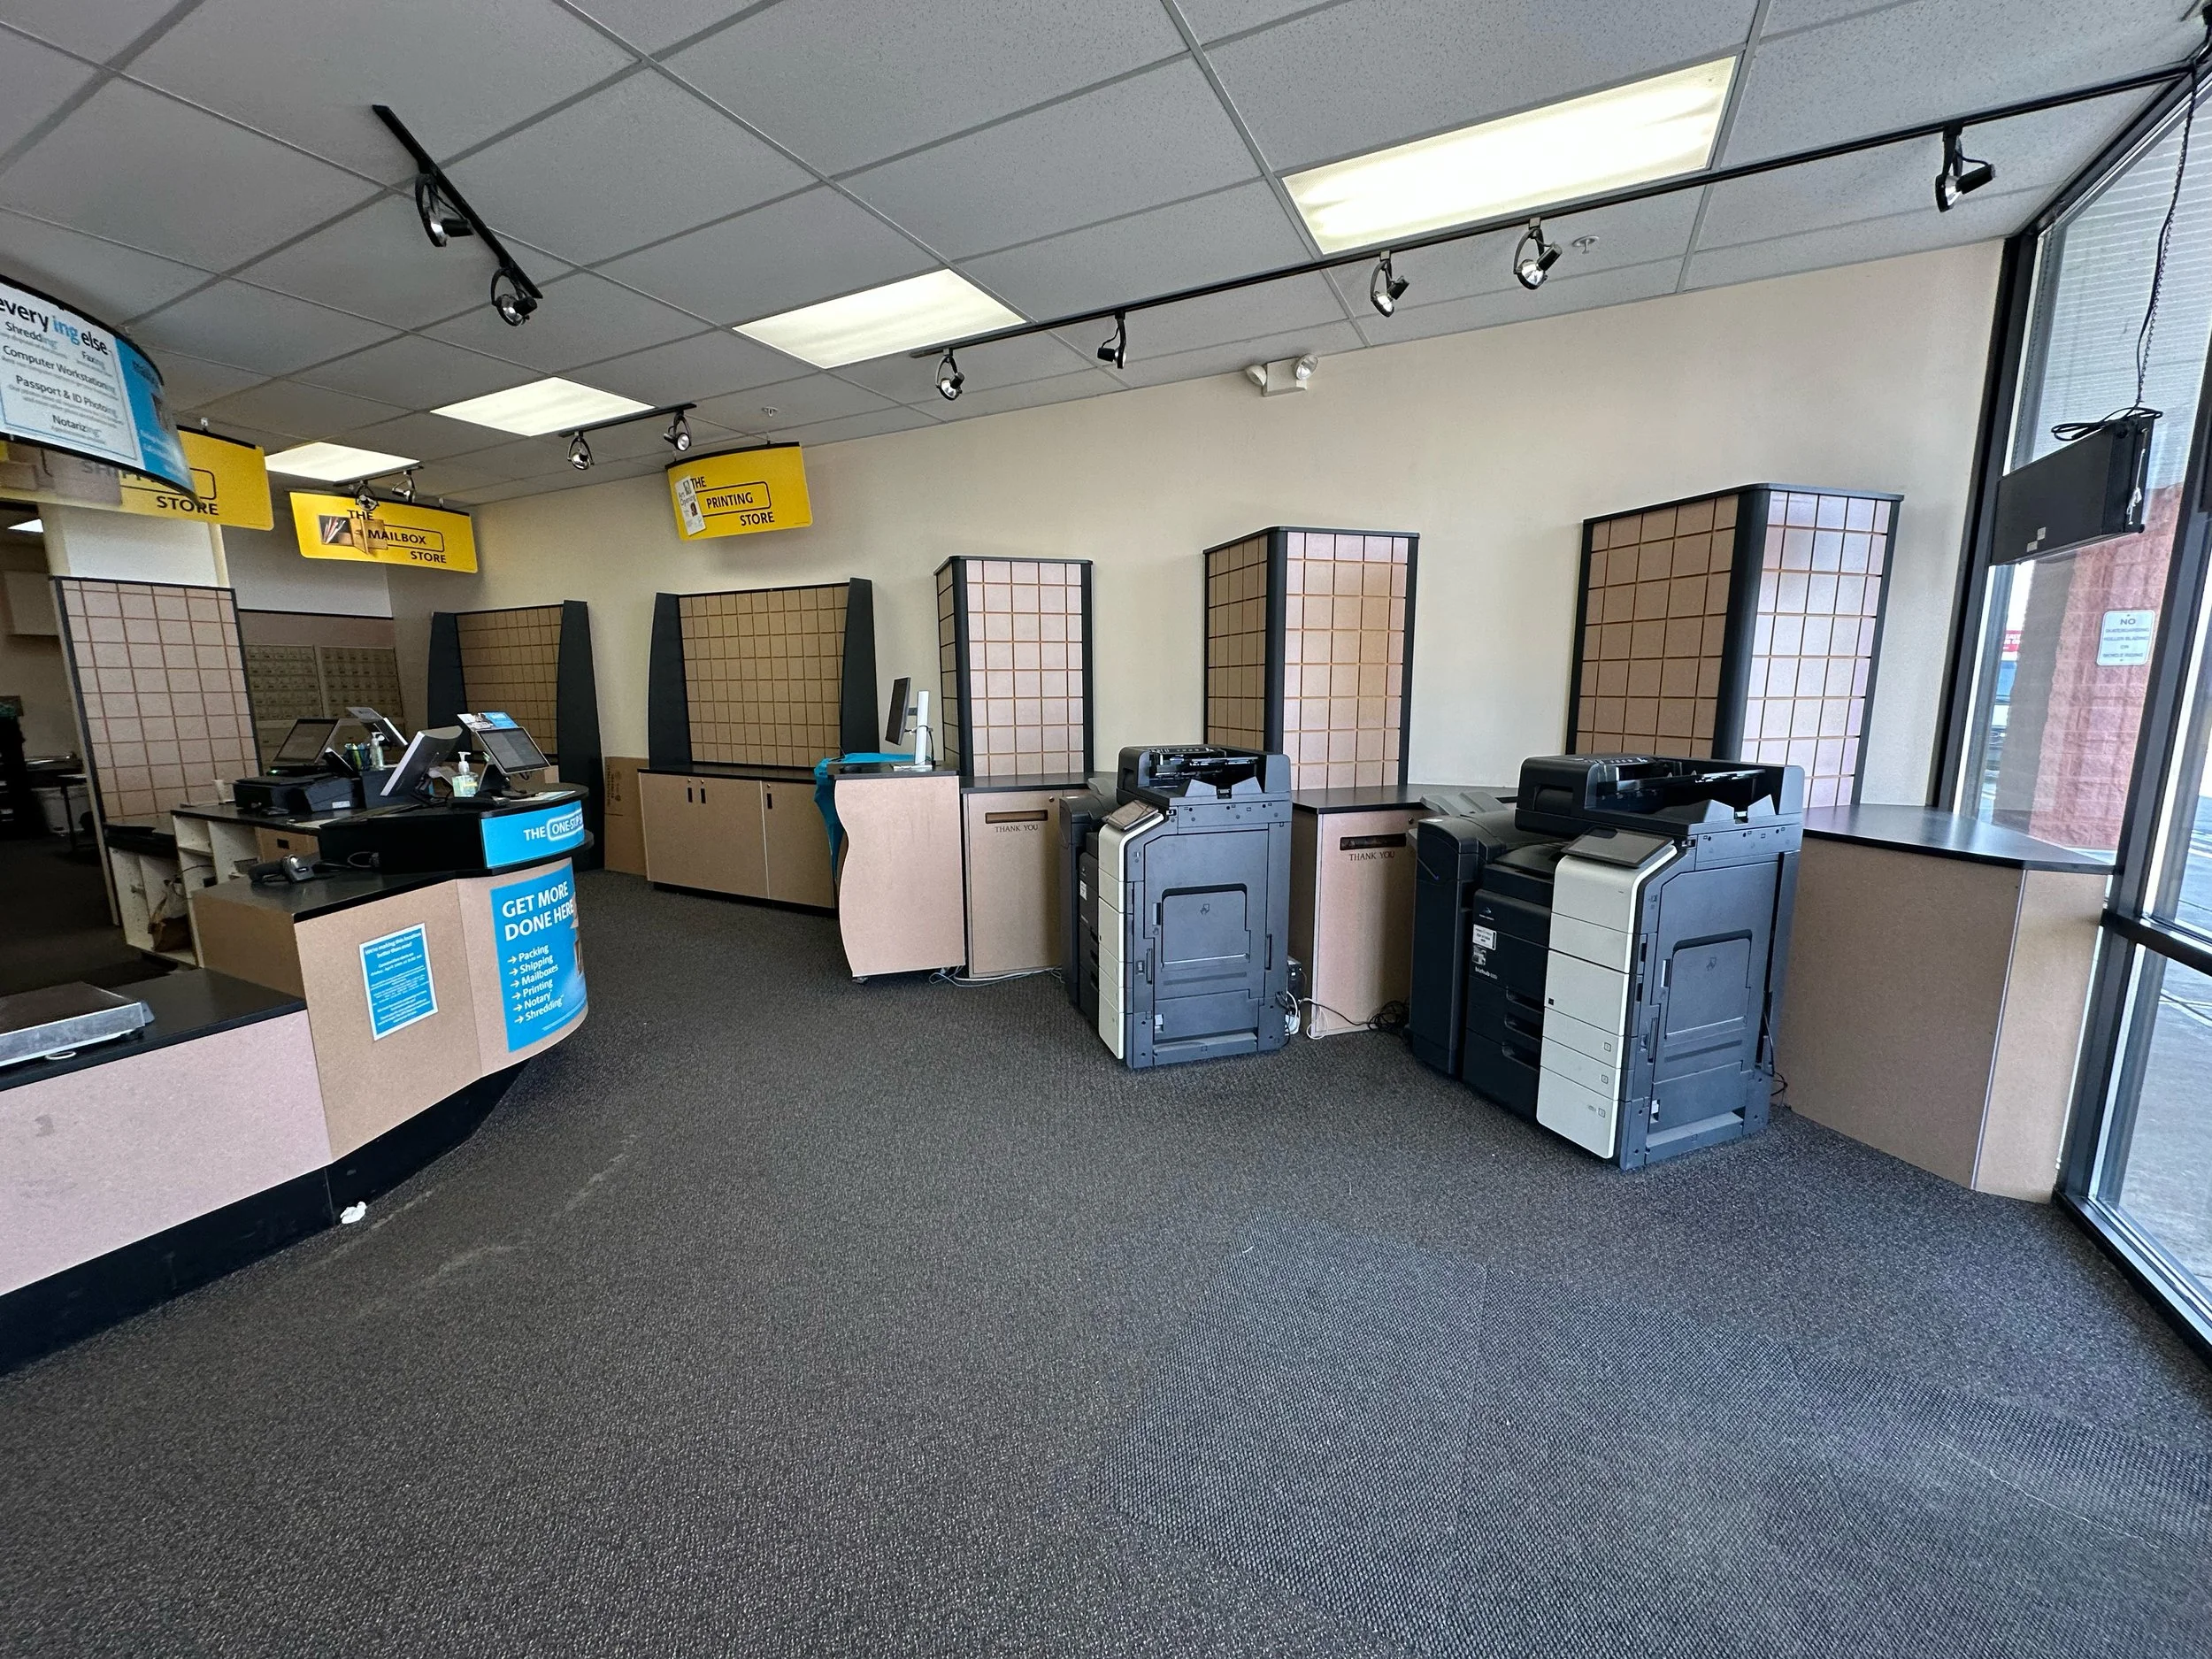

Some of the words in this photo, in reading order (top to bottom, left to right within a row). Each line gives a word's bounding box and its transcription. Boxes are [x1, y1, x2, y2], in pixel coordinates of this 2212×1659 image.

[53, 315, 81, 346] ing
[3, 345, 55, 369] Computer
[16, 374, 61, 397] Passport
[63, 389, 71, 400] &
[73, 393, 82, 403] ID
[690, 476, 707, 489] THE
[156, 495, 219, 516] STORE
[705, 492, 754, 510] PRINTING
[346, 510, 374, 521] THE
[740, 511, 775, 526] STORE
[367, 529, 427, 545] MAILBOX
[410, 550, 447, 564] STORE
[523, 826, 546, 841] THE
[1349, 852, 1377, 861] THANK
[1379, 850, 1395, 859] YOU
[502, 894, 535, 918] GET
[537, 880, 569, 909] MORE
[504, 910, 553, 941] DONE
[553, 898, 574, 924] HERE
[518, 944, 549, 962] Packing
[519, 955, 554, 974] Shipping
[521, 964, 559, 986] Mailboxes
[523, 979, 553, 997] Printing
